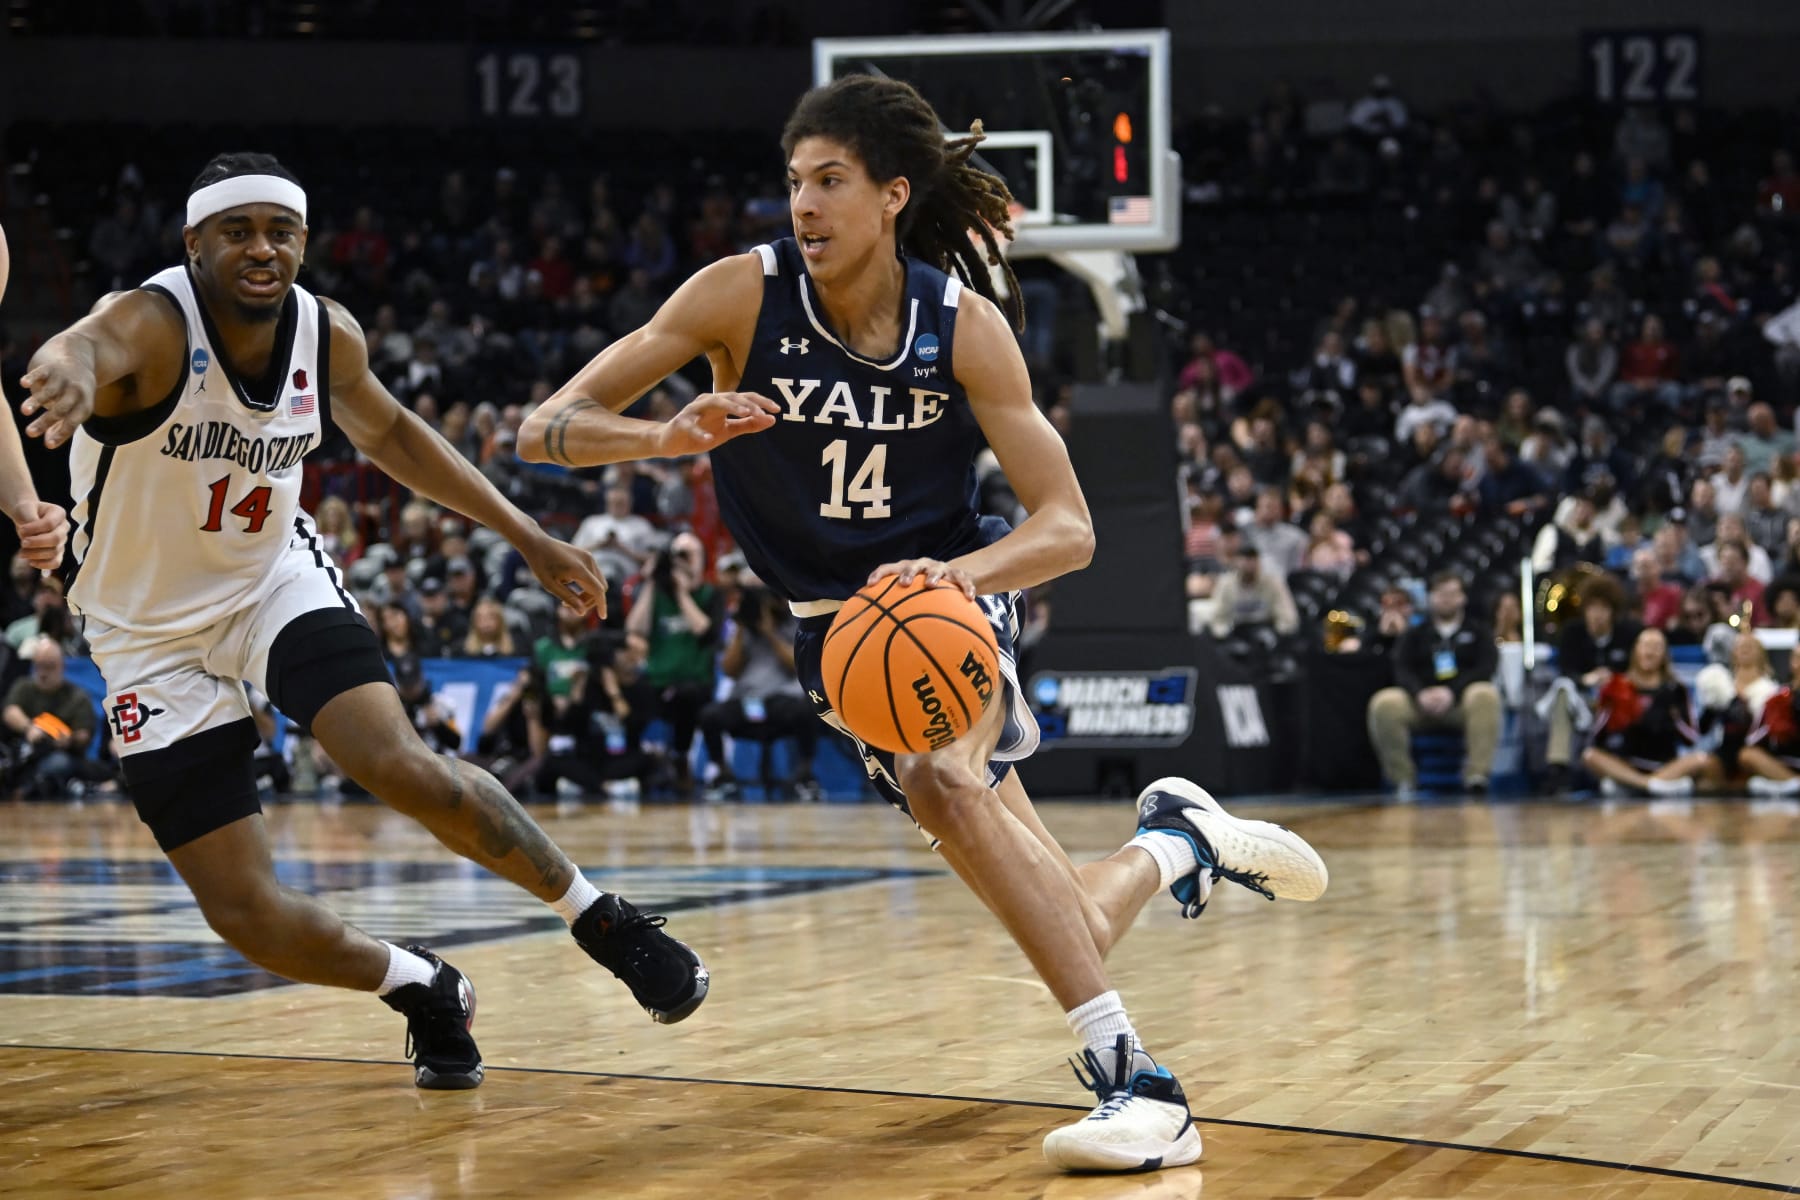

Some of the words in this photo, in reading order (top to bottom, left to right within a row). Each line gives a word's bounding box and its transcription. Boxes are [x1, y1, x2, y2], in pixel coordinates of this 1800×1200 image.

[476, 53, 581, 115] 123
[1589, 36, 1697, 100] 122
[913, 367, 930, 379] Ivy
[771, 377, 950, 431] YALE
[160, 421, 204, 463] SAN
[199, 421, 265, 474] DIEGO
[265, 432, 315, 474] STATE
[199, 473, 273, 534] 14
[819, 438, 892, 520] 14
[911, 673, 958, 752] ilson
[1059, 677, 1149, 704] MARCH
[1067, 704, 1191, 736] MADNESS
